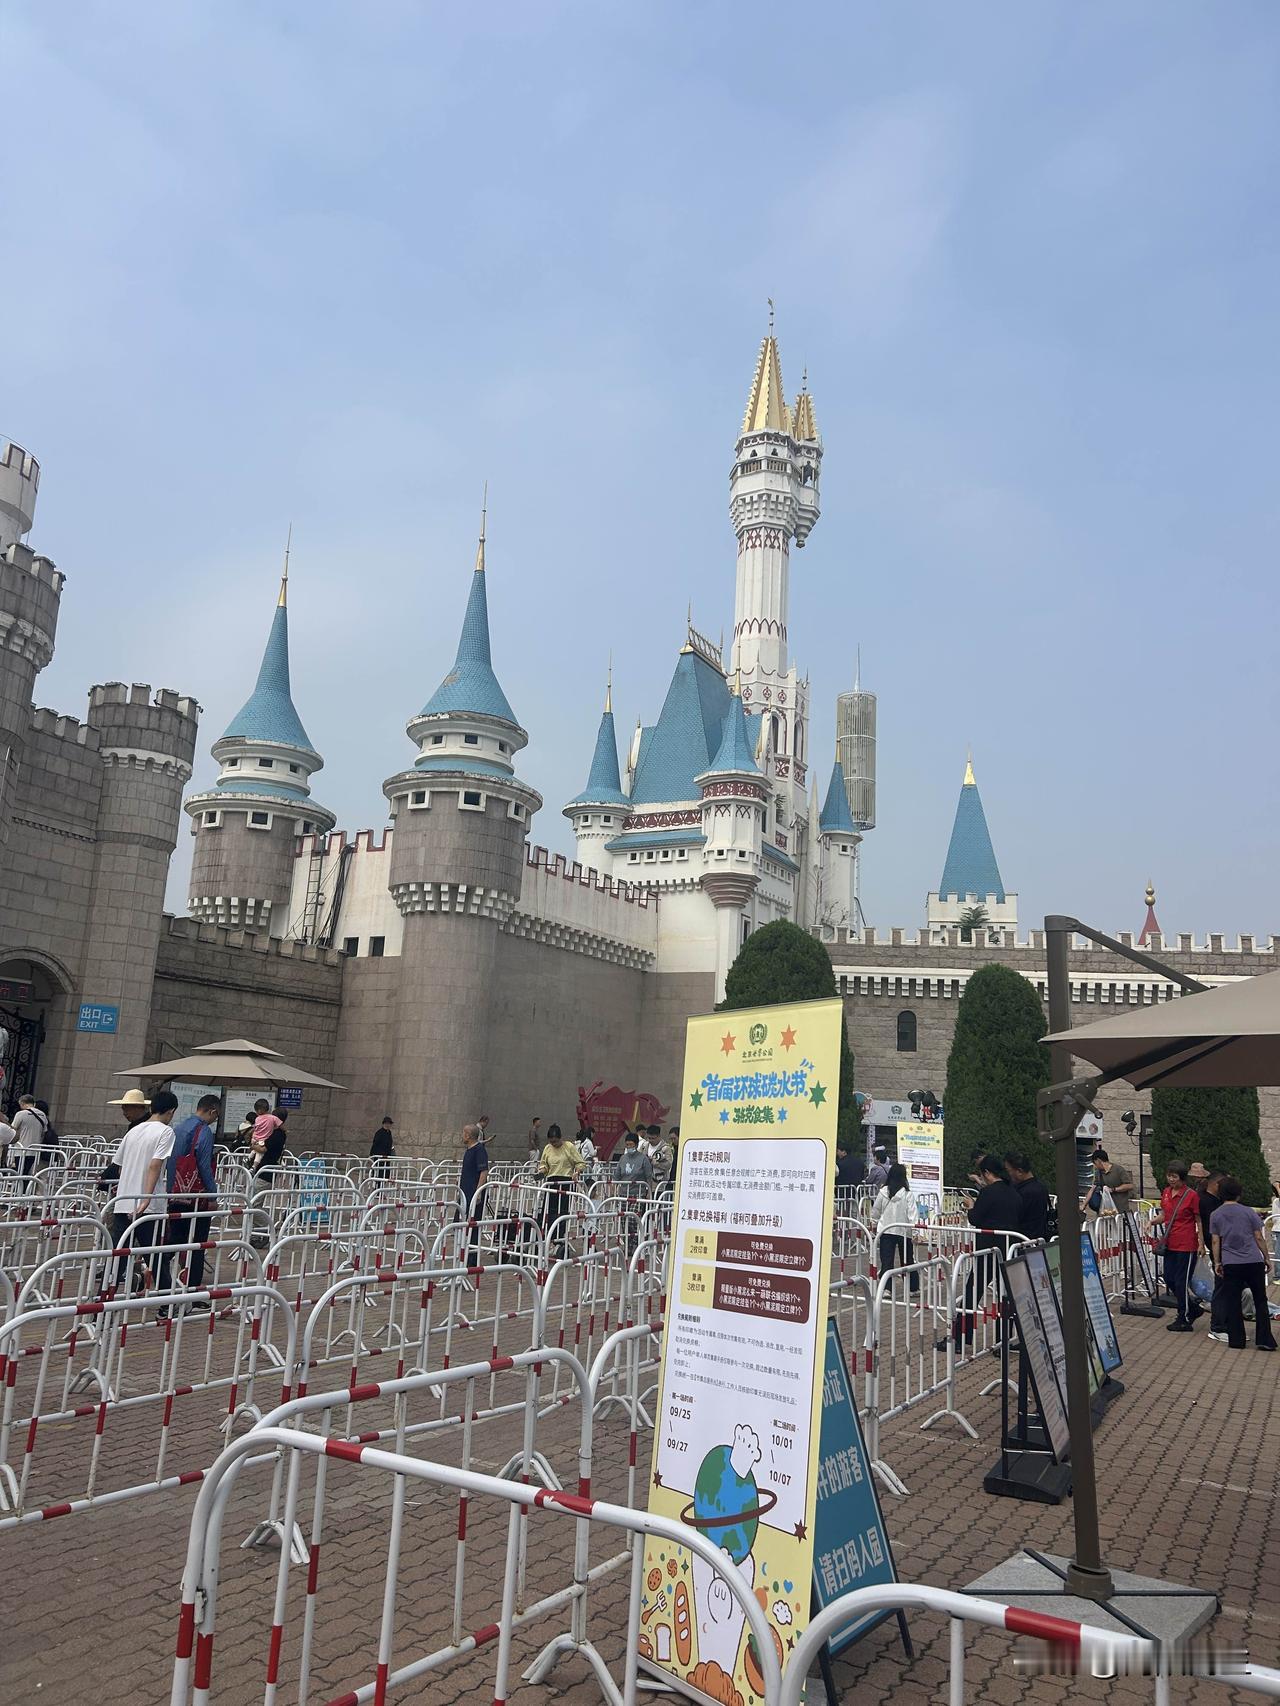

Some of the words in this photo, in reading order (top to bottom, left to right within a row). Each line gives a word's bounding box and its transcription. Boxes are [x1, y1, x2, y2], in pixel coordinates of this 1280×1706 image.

[81, 1007, 102, 1019] 出口
[80, 1021, 98, 1029] EXIT
[701, 1070, 808, 1102] 首届环球碳水节
[669, 1406, 691, 1420] 09/25
[667, 1438, 689, 1452] 09/27
[772, 1434, 793, 1450] 10/01
[769, 1470, 792, 1486] 10/07
[819, 1526, 884, 1598] 请扫码入园
